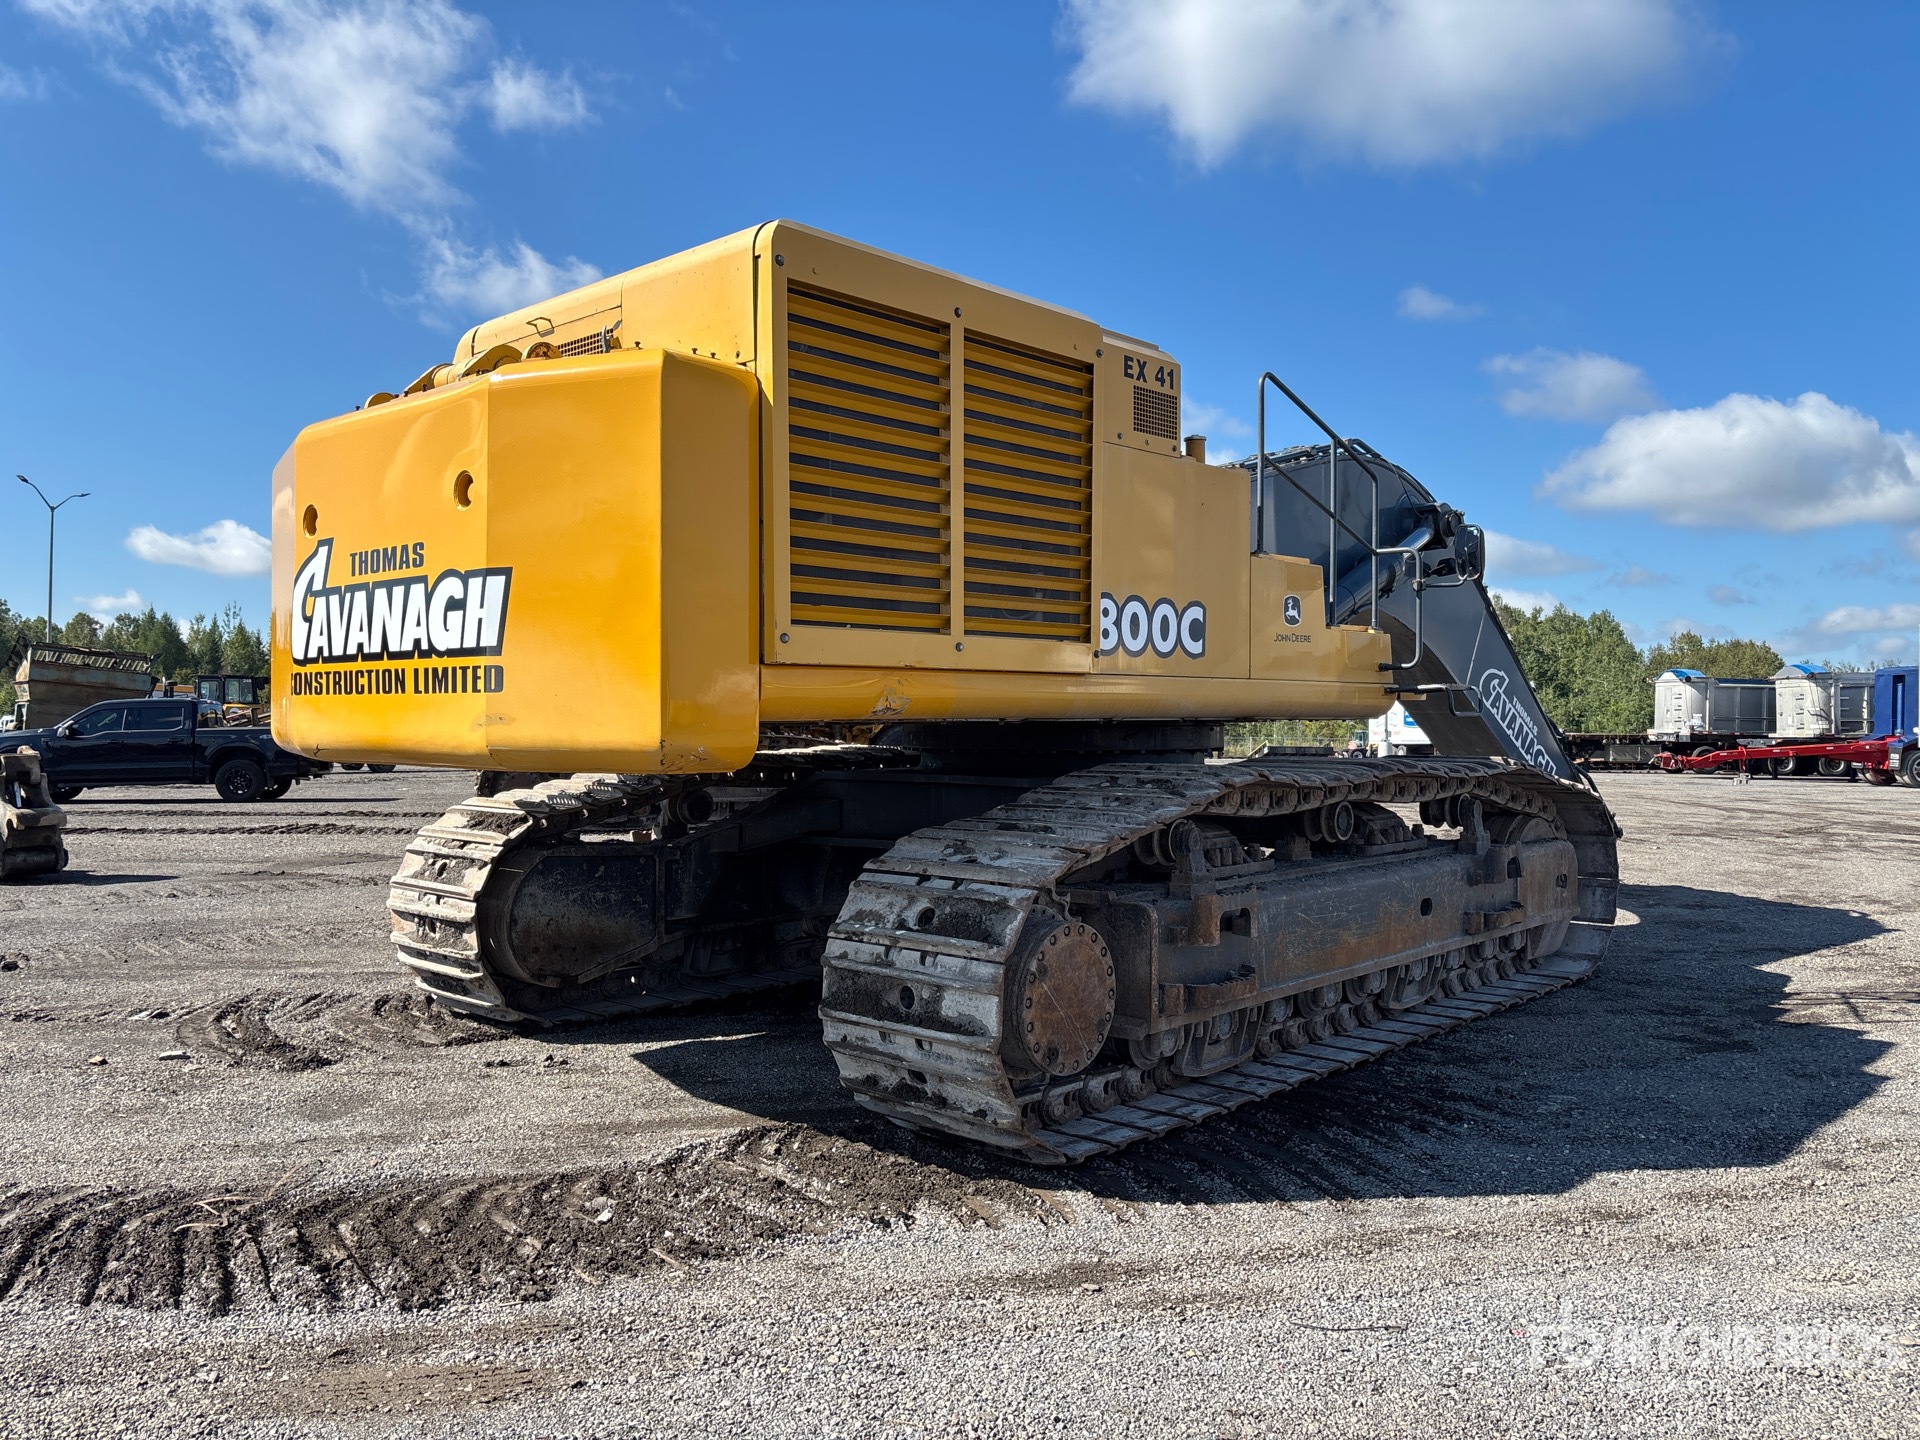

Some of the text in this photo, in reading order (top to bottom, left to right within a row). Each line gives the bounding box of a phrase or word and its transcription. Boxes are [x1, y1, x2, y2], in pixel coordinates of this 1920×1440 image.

[1124, 354, 1174, 390] EX 41
[350, 542, 424, 577] THOMAS
[292, 537, 513, 667] CAVANAGH
[1101, 592, 1206, 659] 800C
[1273, 632, 1311, 643] JOHN DEERE
[291, 664, 504, 696] ONSTRUCTION LIMITED
[1513, 695, 1538, 736] THOMAS
